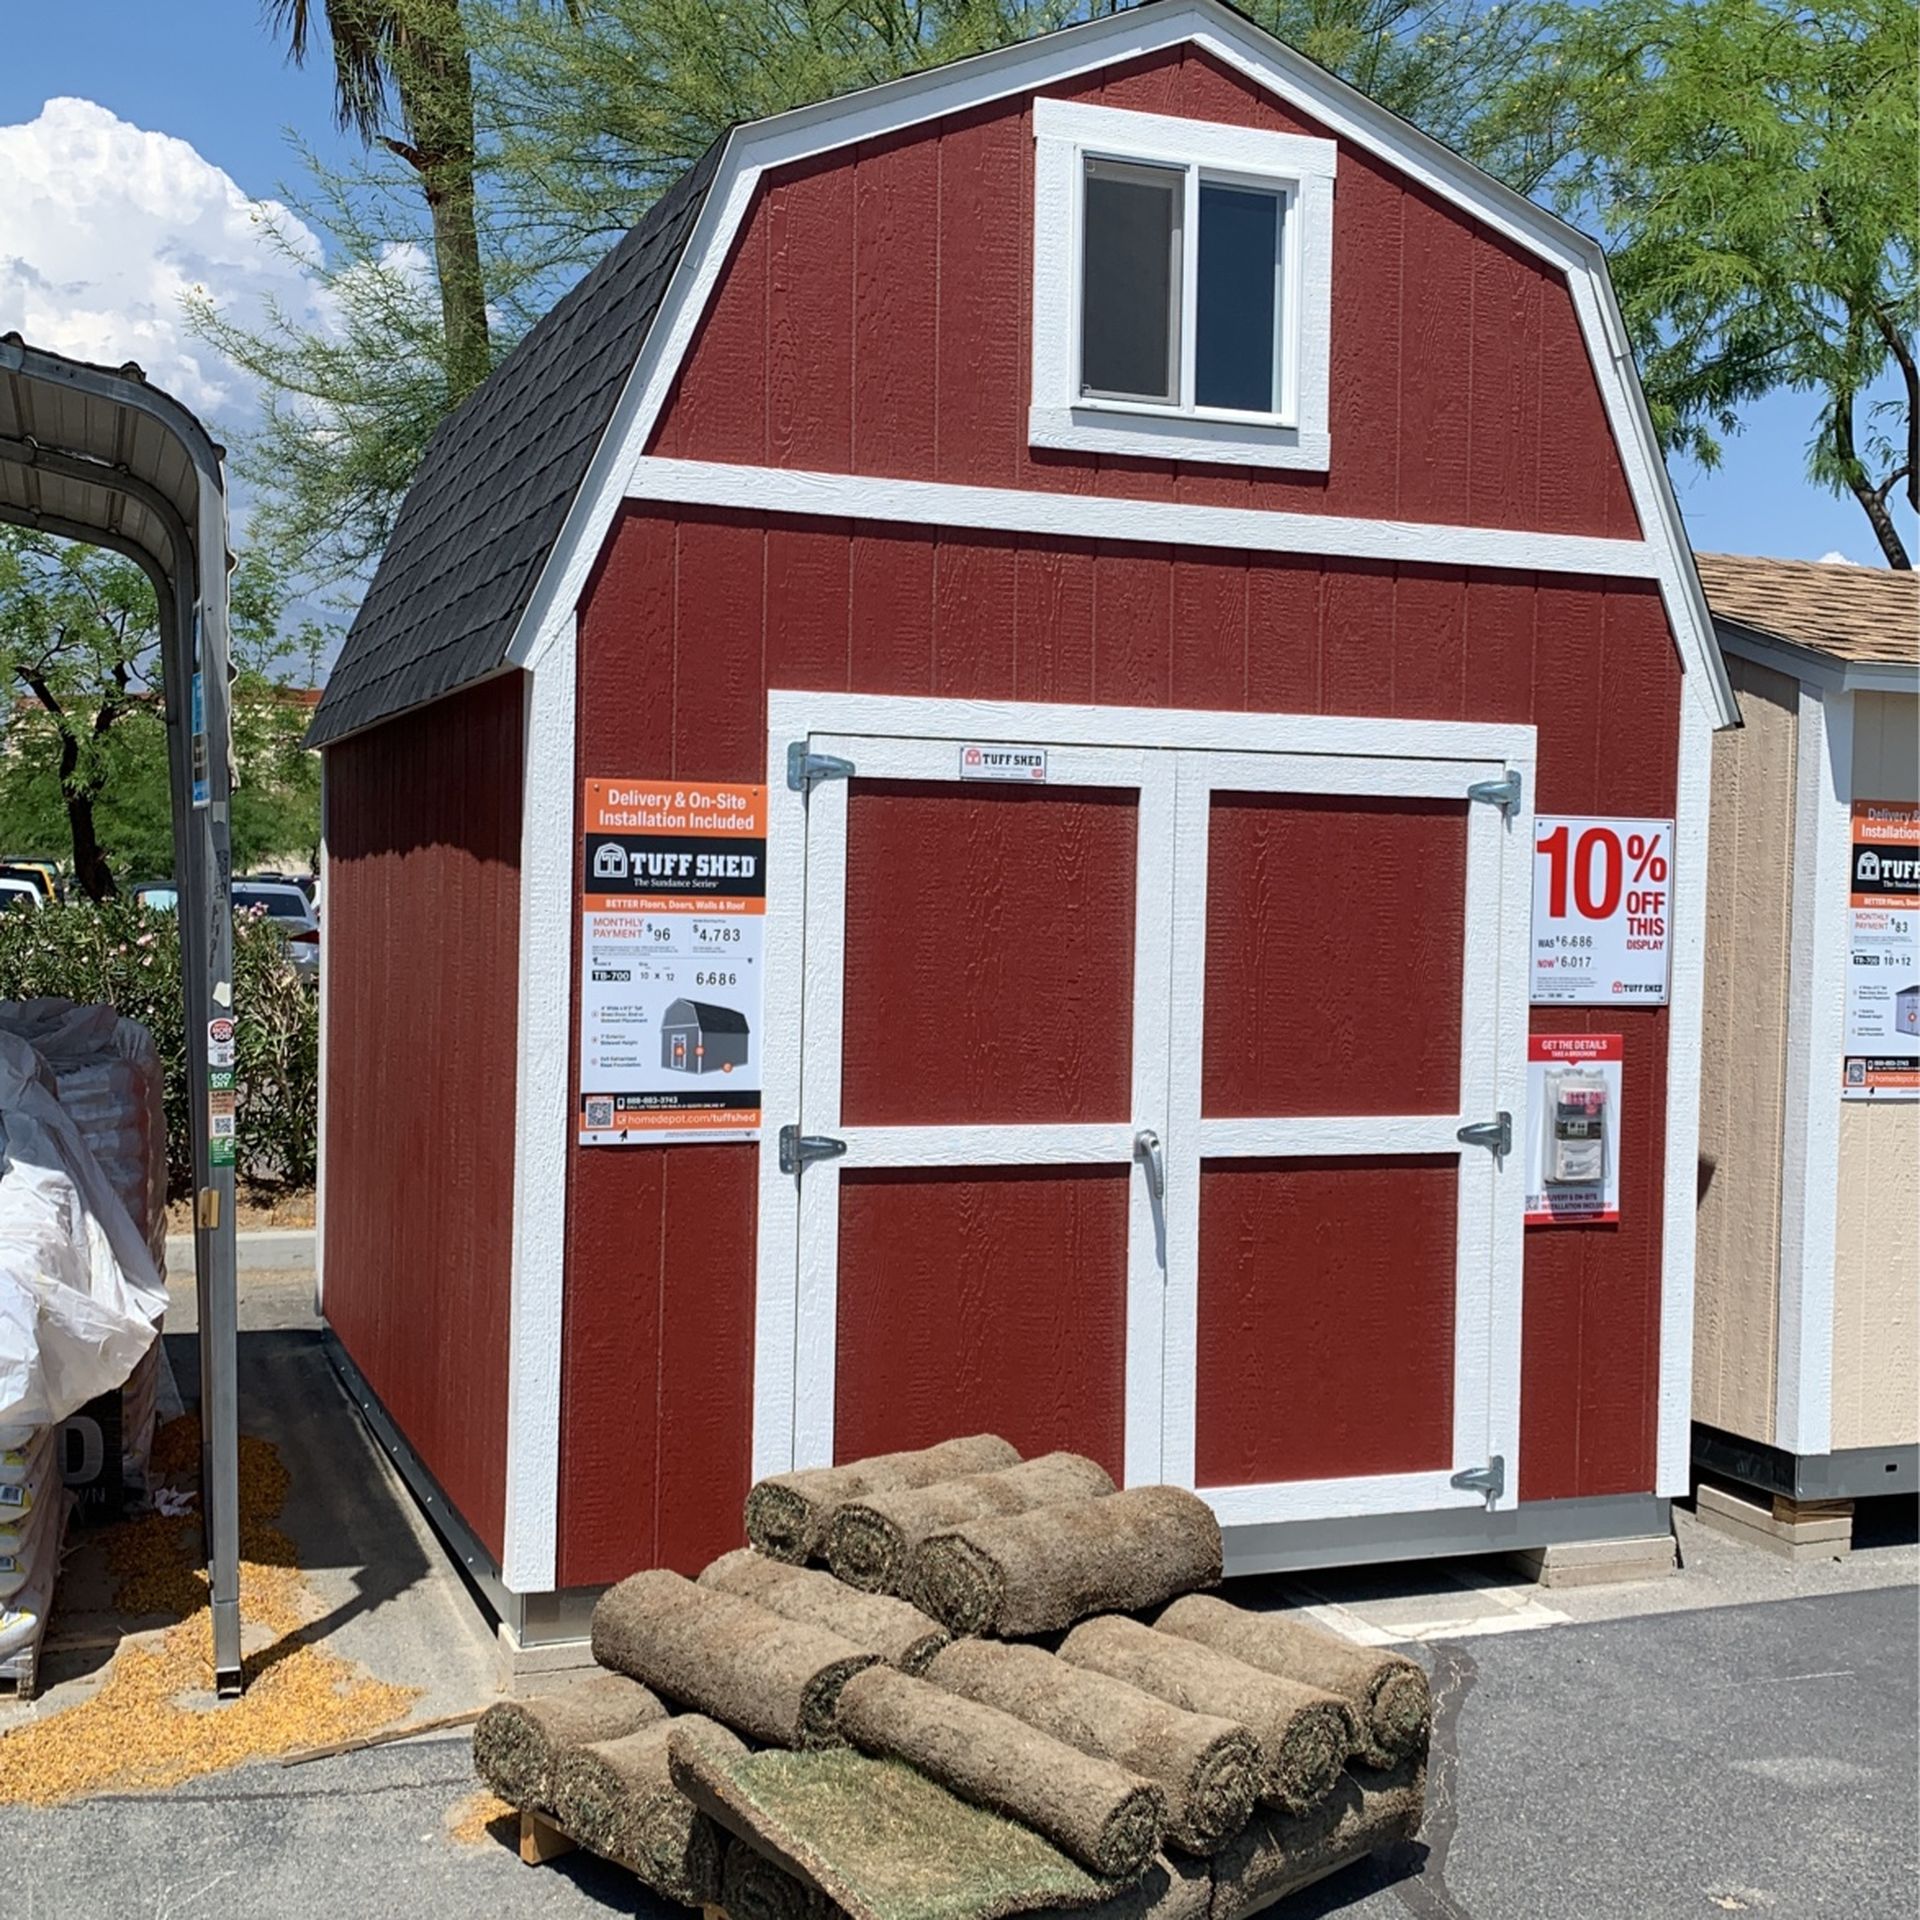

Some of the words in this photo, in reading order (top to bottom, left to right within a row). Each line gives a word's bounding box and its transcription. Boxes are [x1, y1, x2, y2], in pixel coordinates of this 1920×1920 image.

[982, 753, 1012, 765] TUFF
[1013, 755, 1042, 767] SHED
[608, 789, 671, 810] Delivery
[675, 791, 686, 808] &
[689, 792, 747, 809] On-Site
[600, 810, 686, 828] Installation
[690, 812, 754, 830] Included
[1868, 807, 1910, 826] Delivery
[1861, 823, 1920, 840] Installation
[630, 852, 693, 876] TUFF
[696, 855, 756, 878] SHED
[1881, 860, 1920, 879] TUFF
[634, 878, 649, 887] The
[651, 879, 691, 888] Sundance
[693, 880, 717, 889] Series
[606, 898, 639, 909] BETTER
[696, 901, 717, 910] Walls
[1626, 891, 1666, 915] OFF
[1855, 912, 1889, 921] MONTHLY
[593, 918, 644, 927] MONTHLY
[1627, 917, 1665, 936] THIS
[1855, 921, 1888, 930] PAYMENT
[592, 929, 643, 939] PAYMENT
[1538, 939, 1555, 949] WAS
[1626, 939, 1664, 950] DISPLAY
[1537, 959, 1555, 969] NOW
[666, 973, 674, 981] 12
[1624, 984, 1643, 993] TUFF
[1644, 984, 1663, 993] SHED
[1541, 1040, 1559, 1051] GET
[1559, 1040, 1574, 1050] THE
[1575, 1040, 1608, 1050] DETAILS
[628, 1112, 756, 1126] homedepot.com/tuffshed
